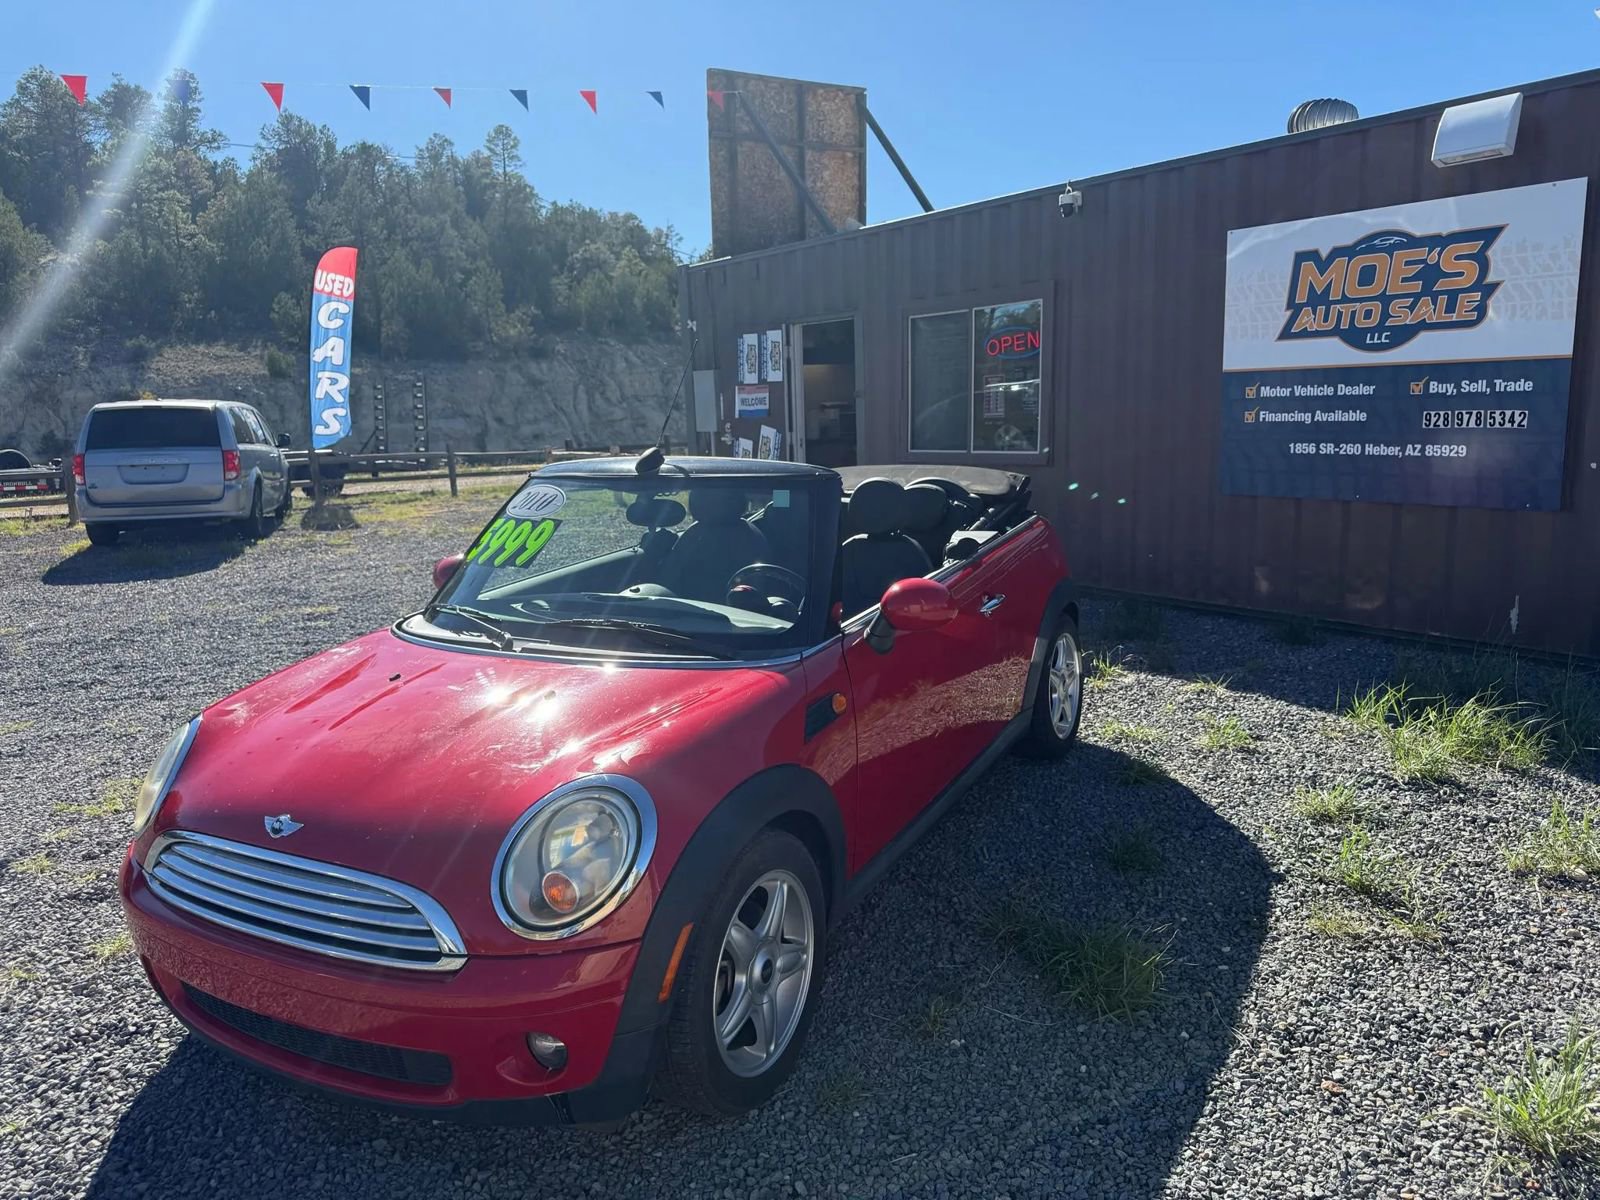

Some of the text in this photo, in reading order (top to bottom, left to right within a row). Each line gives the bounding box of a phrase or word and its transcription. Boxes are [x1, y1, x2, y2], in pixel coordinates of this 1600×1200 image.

[1295, 241, 1484, 303] MOE'S
[315, 268, 354, 298] USED
[1291, 292, 1482, 333] AUTO SALE
[986, 330, 1040, 356] OPEN
[1366, 332, 1391, 344] LLC
[312, 301, 350, 436] CARS
[1260, 383, 1376, 397] Motor Vehicle Dealer
[1429, 379, 1534, 396] Buy, Sell, Trade
[740, 396, 767, 407] WELCOME
[1259, 409, 1367, 424] Financing Available
[1423, 410, 1527, 428] 928 978 5342
[1289, 442, 1467, 458] 1856 SR-260 Heber, AZ 85929
[466, 518, 555, 567] 5999
